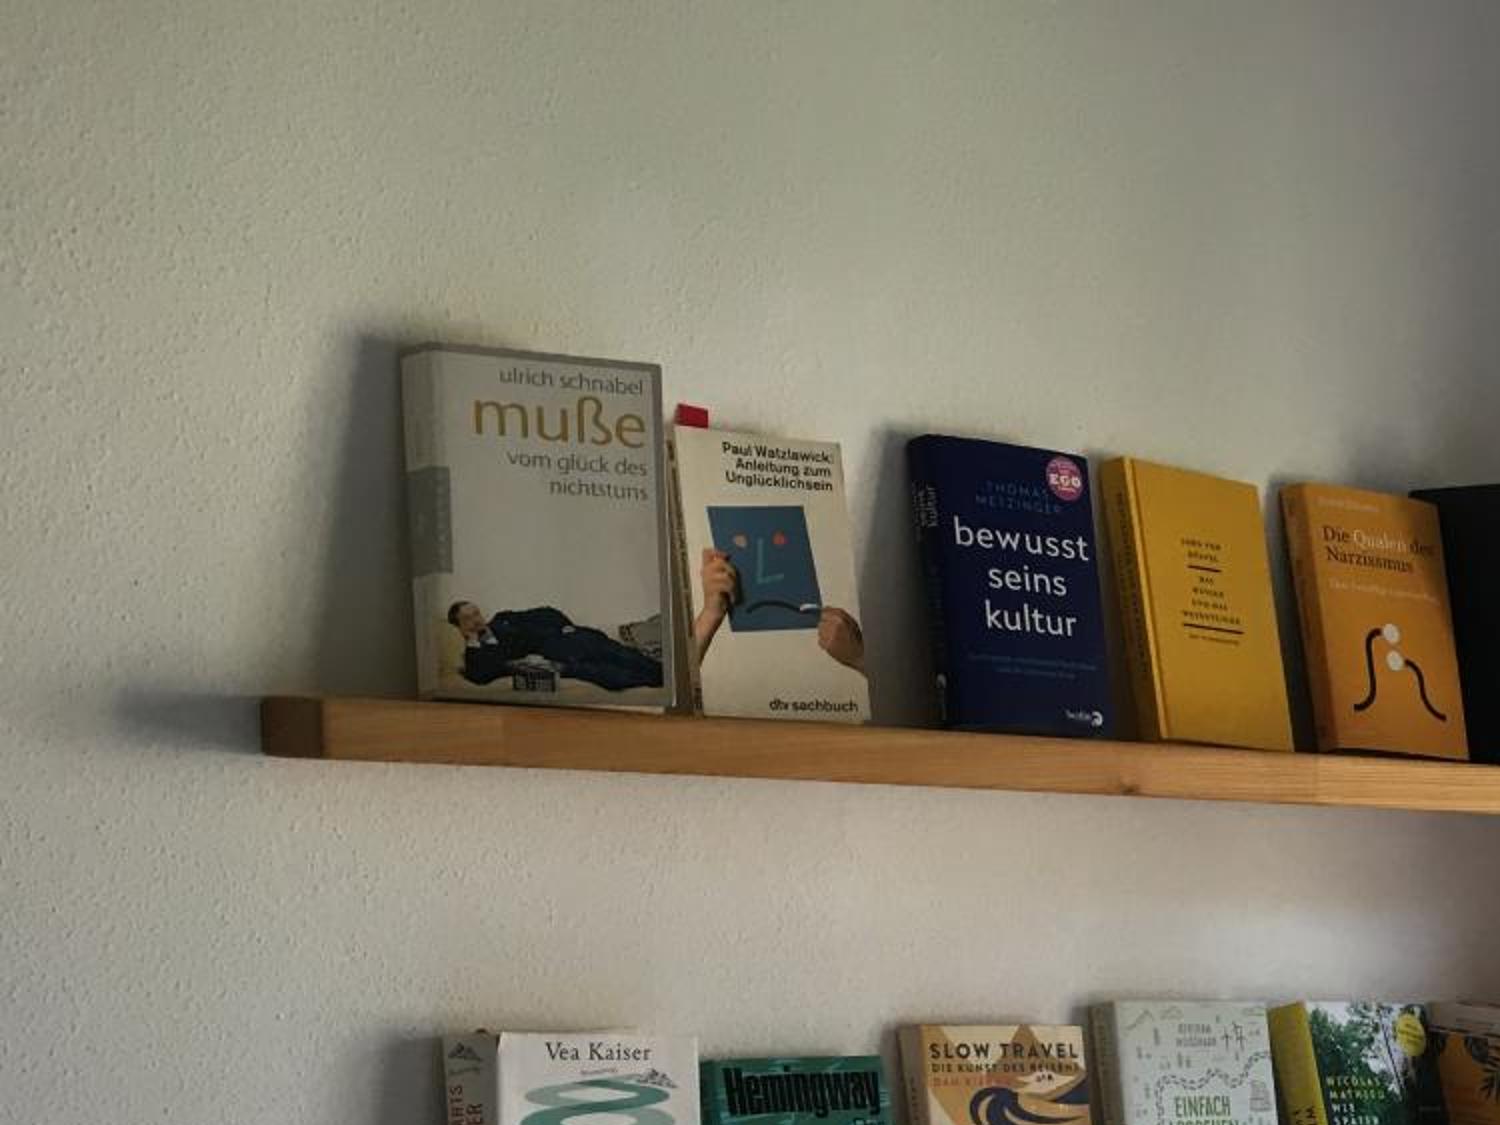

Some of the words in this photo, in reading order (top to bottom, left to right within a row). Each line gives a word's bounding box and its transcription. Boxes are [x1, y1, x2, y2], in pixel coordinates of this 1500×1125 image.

[499, 367, 552, 386] ulrich
[559, 371, 644, 396] schnabel
[473, 396, 646, 449] muße
[720, 440, 753, 457] Paul
[506, 450, 552, 468] vom
[614, 458, 648, 478] des
[735, 458, 798, 477] Anleitung
[802, 465, 833, 479] zum
[549, 478, 649, 502] nichtstuns
[952, 514, 1090, 561] bewusst
[1321, 524, 1351, 543] Die
[987, 565, 1069, 597] seins
[984, 598, 1078, 638] kultur
[546, 1042, 580, 1061] Vea
[589, 1045, 653, 1062] Kaiser
[929, 1043, 991, 1060] SLOW
[1000, 1042, 1080, 1059] TRAVEL
[722, 1067, 881, 1118] Hemingway
[1174, 1096, 1231, 1119] EINFACH
